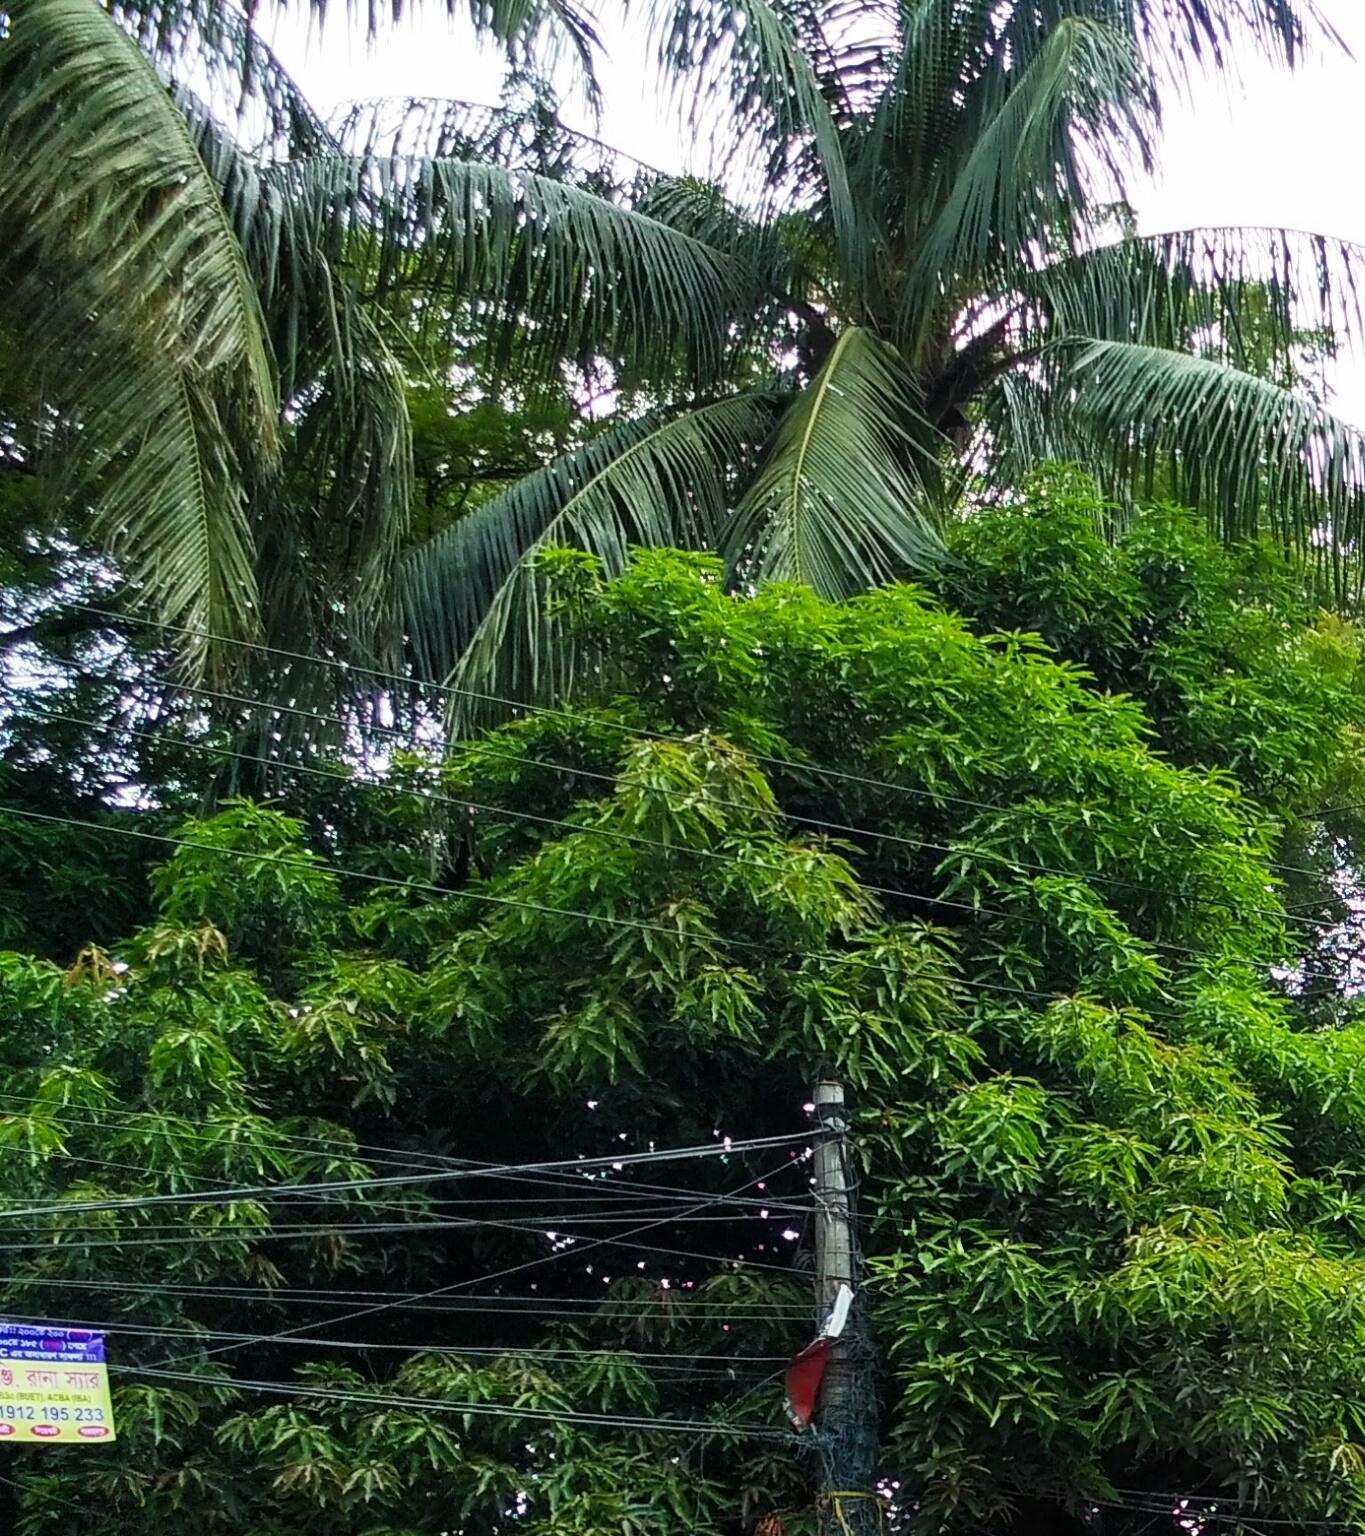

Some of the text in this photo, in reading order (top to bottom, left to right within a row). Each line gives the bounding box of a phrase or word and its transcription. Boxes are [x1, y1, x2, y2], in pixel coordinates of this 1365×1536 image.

[25, 1369, 100, 1390] রানা স্যার
[40, 1406, 70, 1421] 195
[74, 1407, 104, 1421] 233
